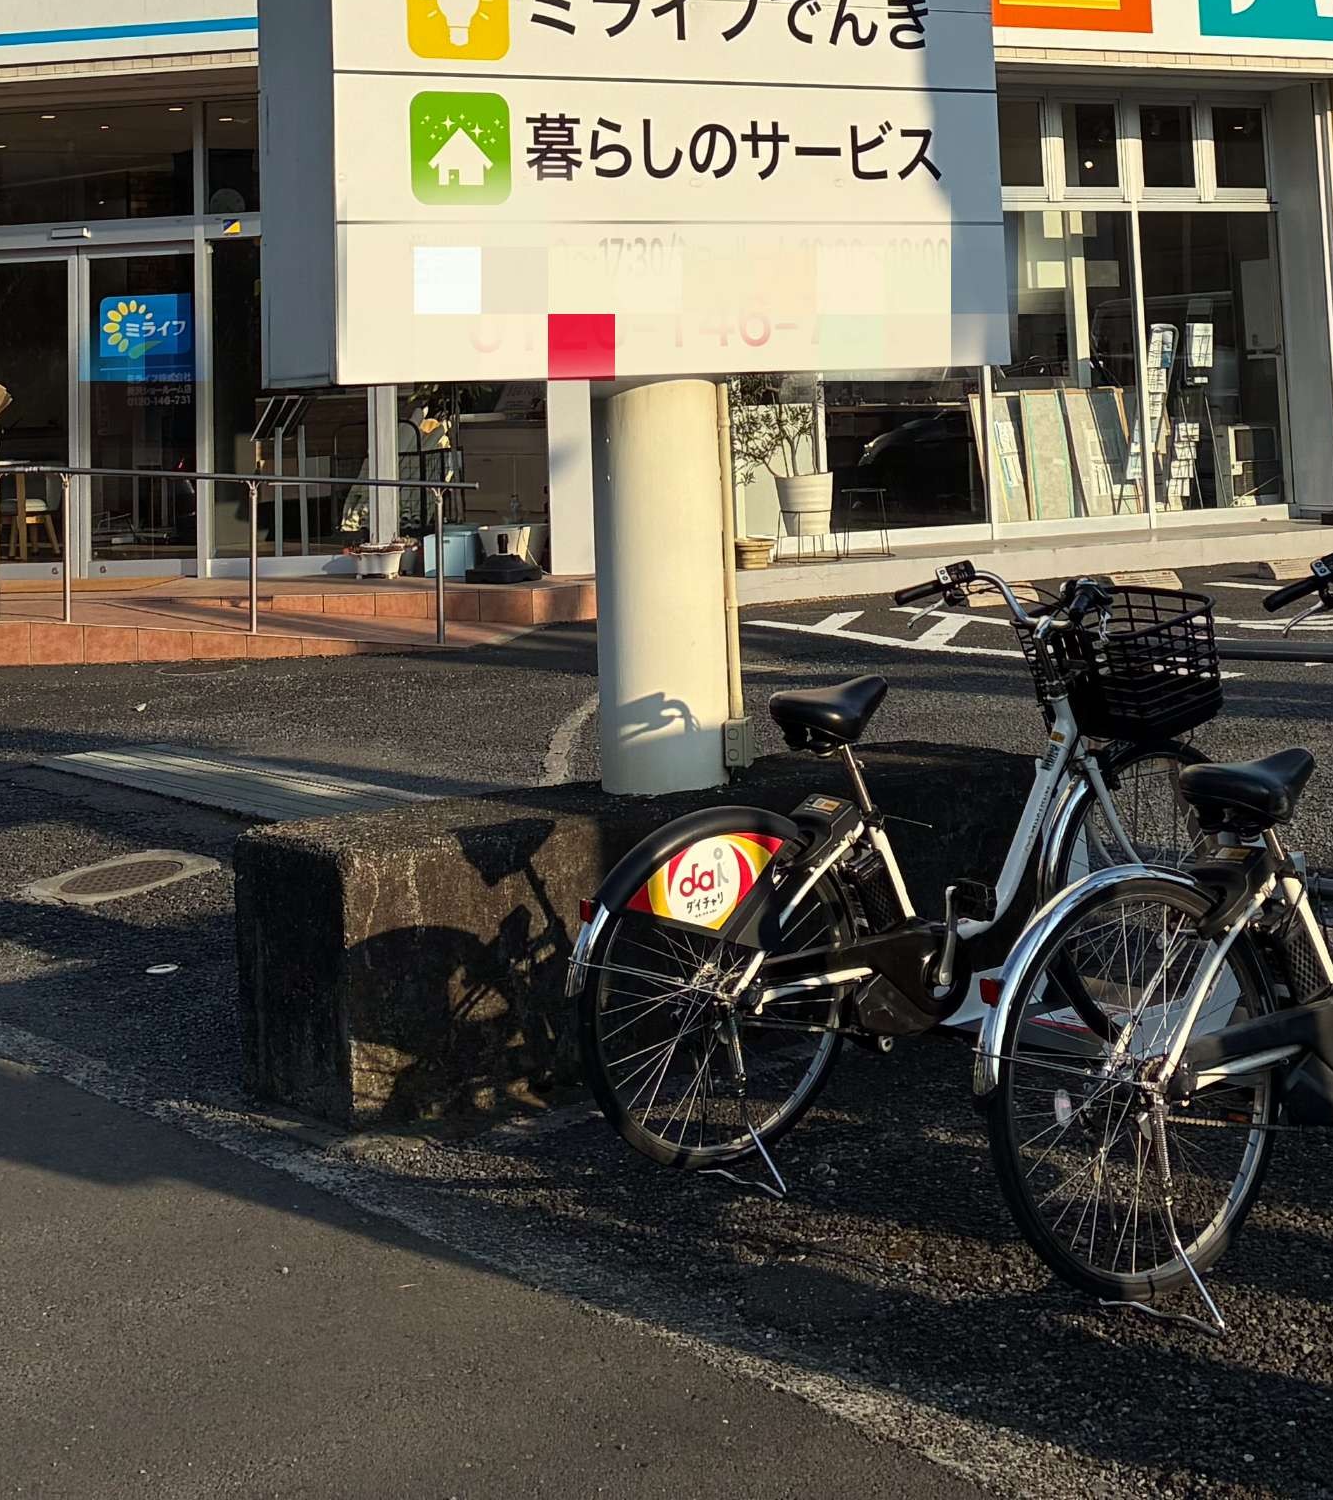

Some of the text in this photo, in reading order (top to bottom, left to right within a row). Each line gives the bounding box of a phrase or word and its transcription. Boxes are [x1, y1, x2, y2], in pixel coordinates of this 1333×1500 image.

[525, 112, 943, 183] 暮らしのサービス
[126, 321, 186, 338] ミライフ
[686, 891, 724, 915] ダイチャリ
